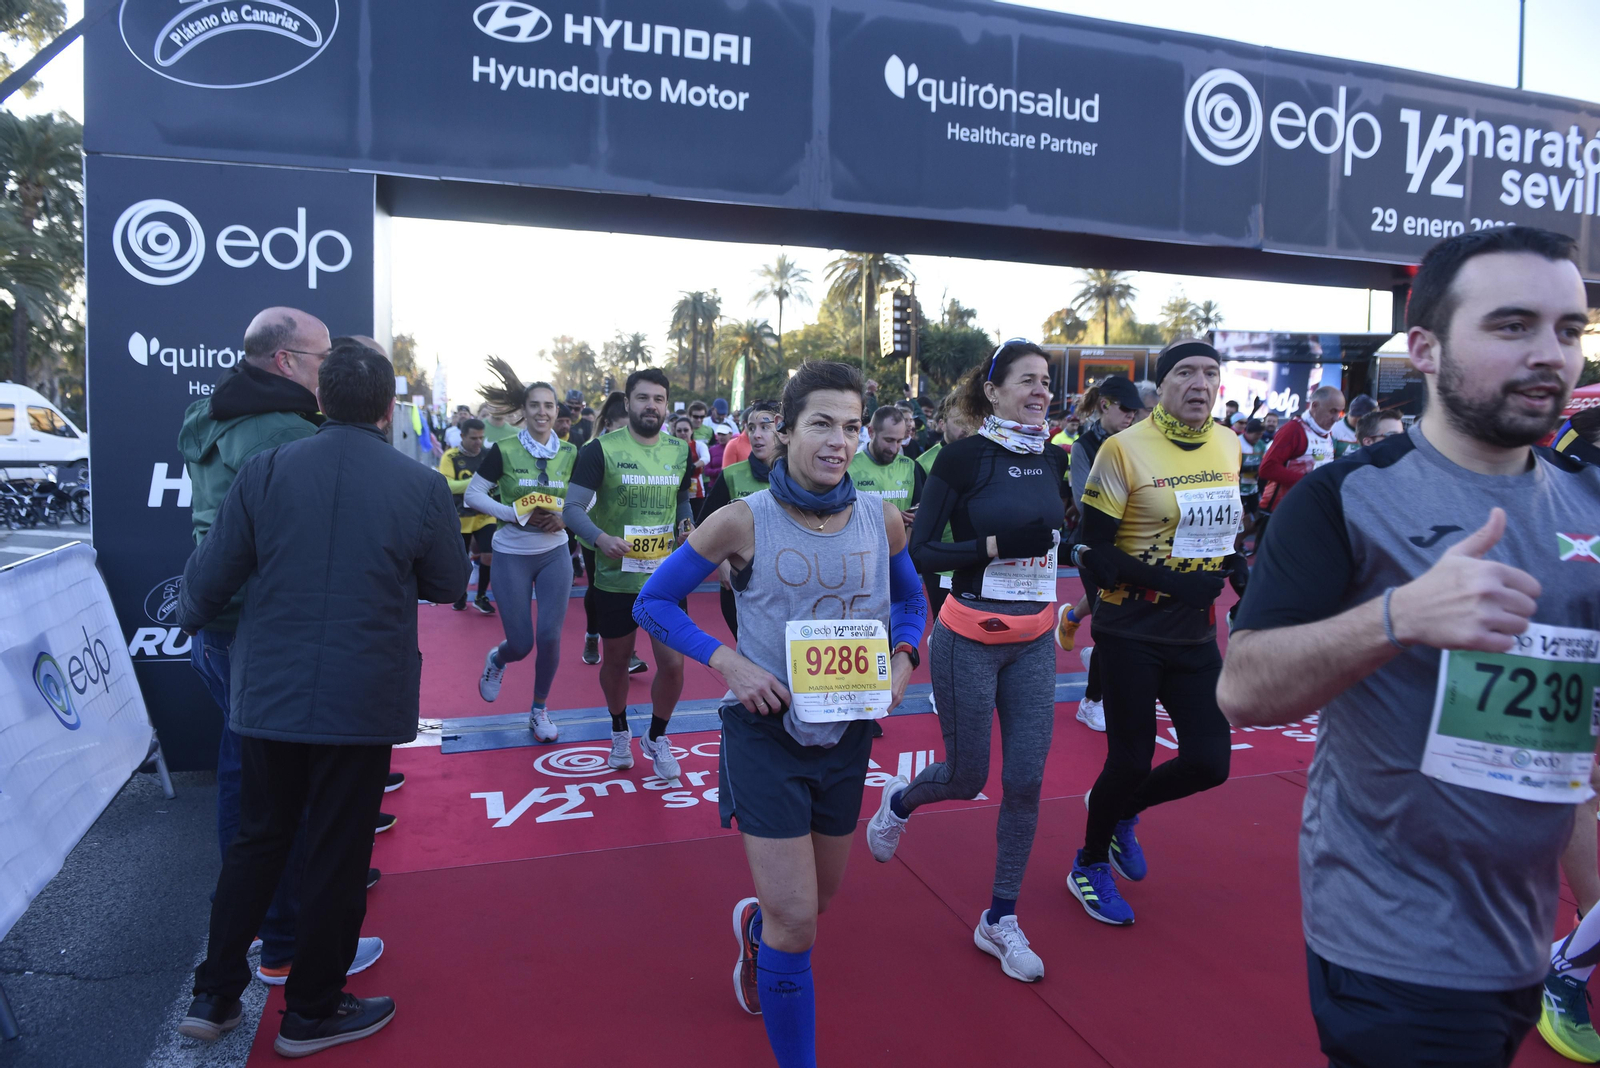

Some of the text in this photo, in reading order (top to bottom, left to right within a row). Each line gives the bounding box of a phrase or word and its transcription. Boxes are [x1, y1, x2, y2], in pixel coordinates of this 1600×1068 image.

[169, 4, 300, 47] Plátano de Canarias
[564, 13, 751, 66] HYUNDAI
[472, 55, 749, 111] Hyundauto Motor
[917, 76, 1100, 123] quirónsalud
[947, 122, 1098, 156] Healthcare Partner
[1269, 85, 1382, 177] edp
[1371, 206, 1398, 233] 29
[215, 206, 352, 289] edp
[1267, 386, 1300, 419] edp
[616, 461, 638, 470] HOKA
[621, 473, 680, 486] MEDIO MARATÓN
[521, 494, 553, 507] 8846
[882, 488, 909, 499] MARATÓN
[1188, 504, 1231, 527] 11141
[632, 537, 665, 552] 8874
[775, 548, 871, 590] OUT
[814, 625, 832, 637] edp
[68, 625, 111, 695] edp
[805, 645, 869, 676] 9286
[840, 691, 856, 702] edp
[1475, 662, 1583, 723] 7239
